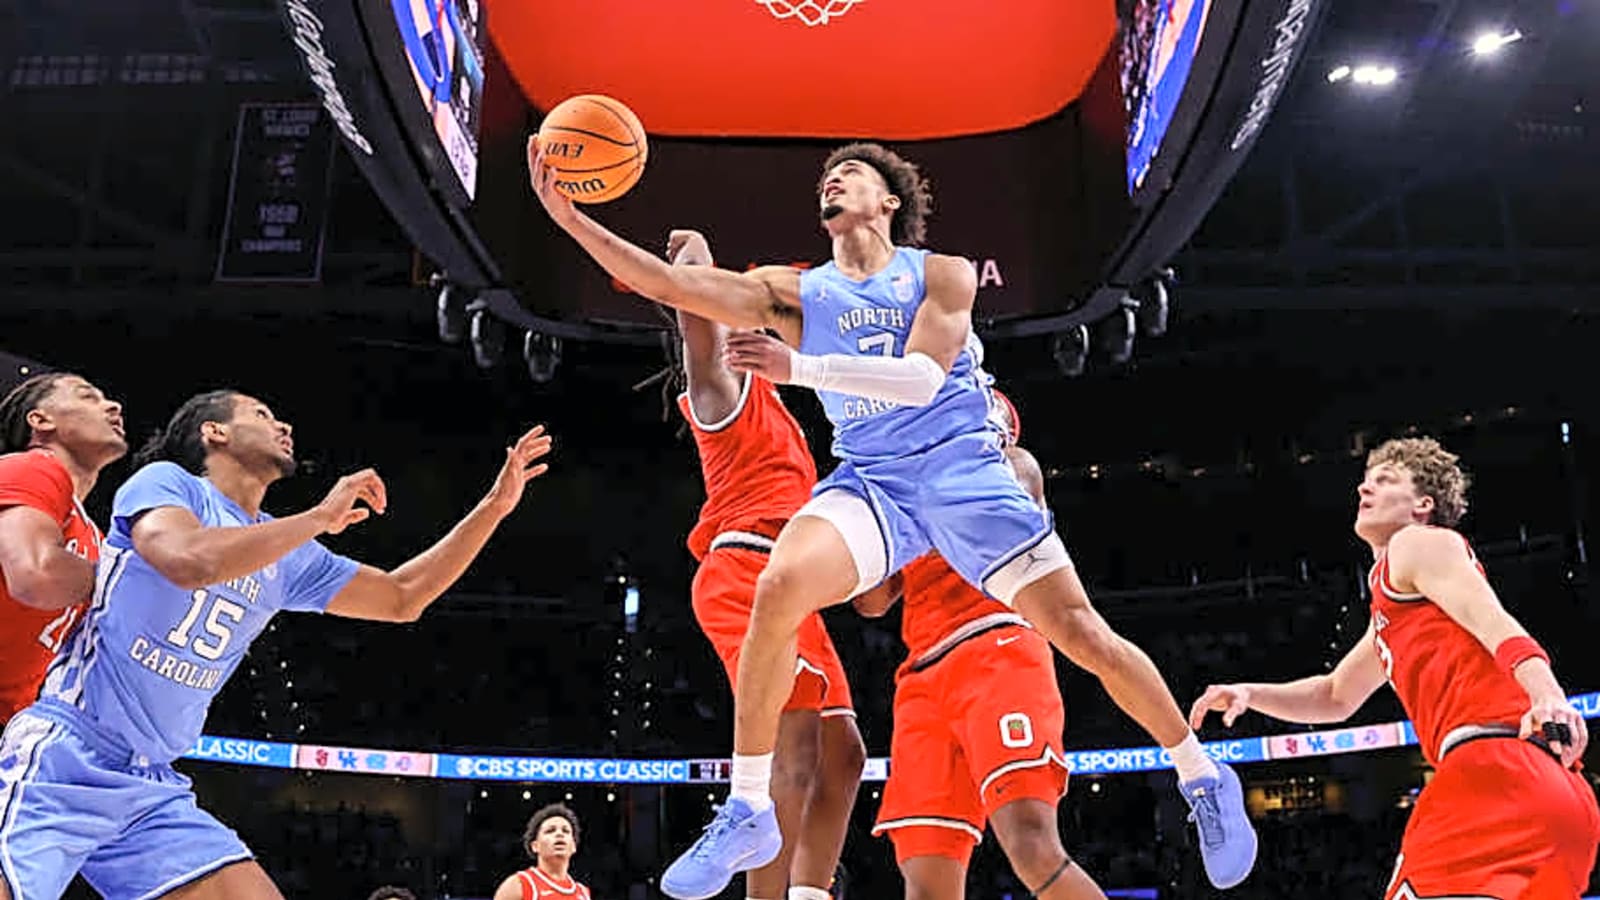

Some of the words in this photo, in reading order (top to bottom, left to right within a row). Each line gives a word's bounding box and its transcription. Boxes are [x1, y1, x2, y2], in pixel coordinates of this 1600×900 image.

[974, 259, 1003, 287] A
[837, 308, 905, 337] NORTH
[166, 588, 246, 661] 15
[129, 635, 220, 690] CAROLIN
[474, 758, 514, 776] CBS
[516, 759, 597, 779] SPORTS
[599, 760, 684, 781] CLASSIC
[1078, 750, 1156, 771] SPORTS
